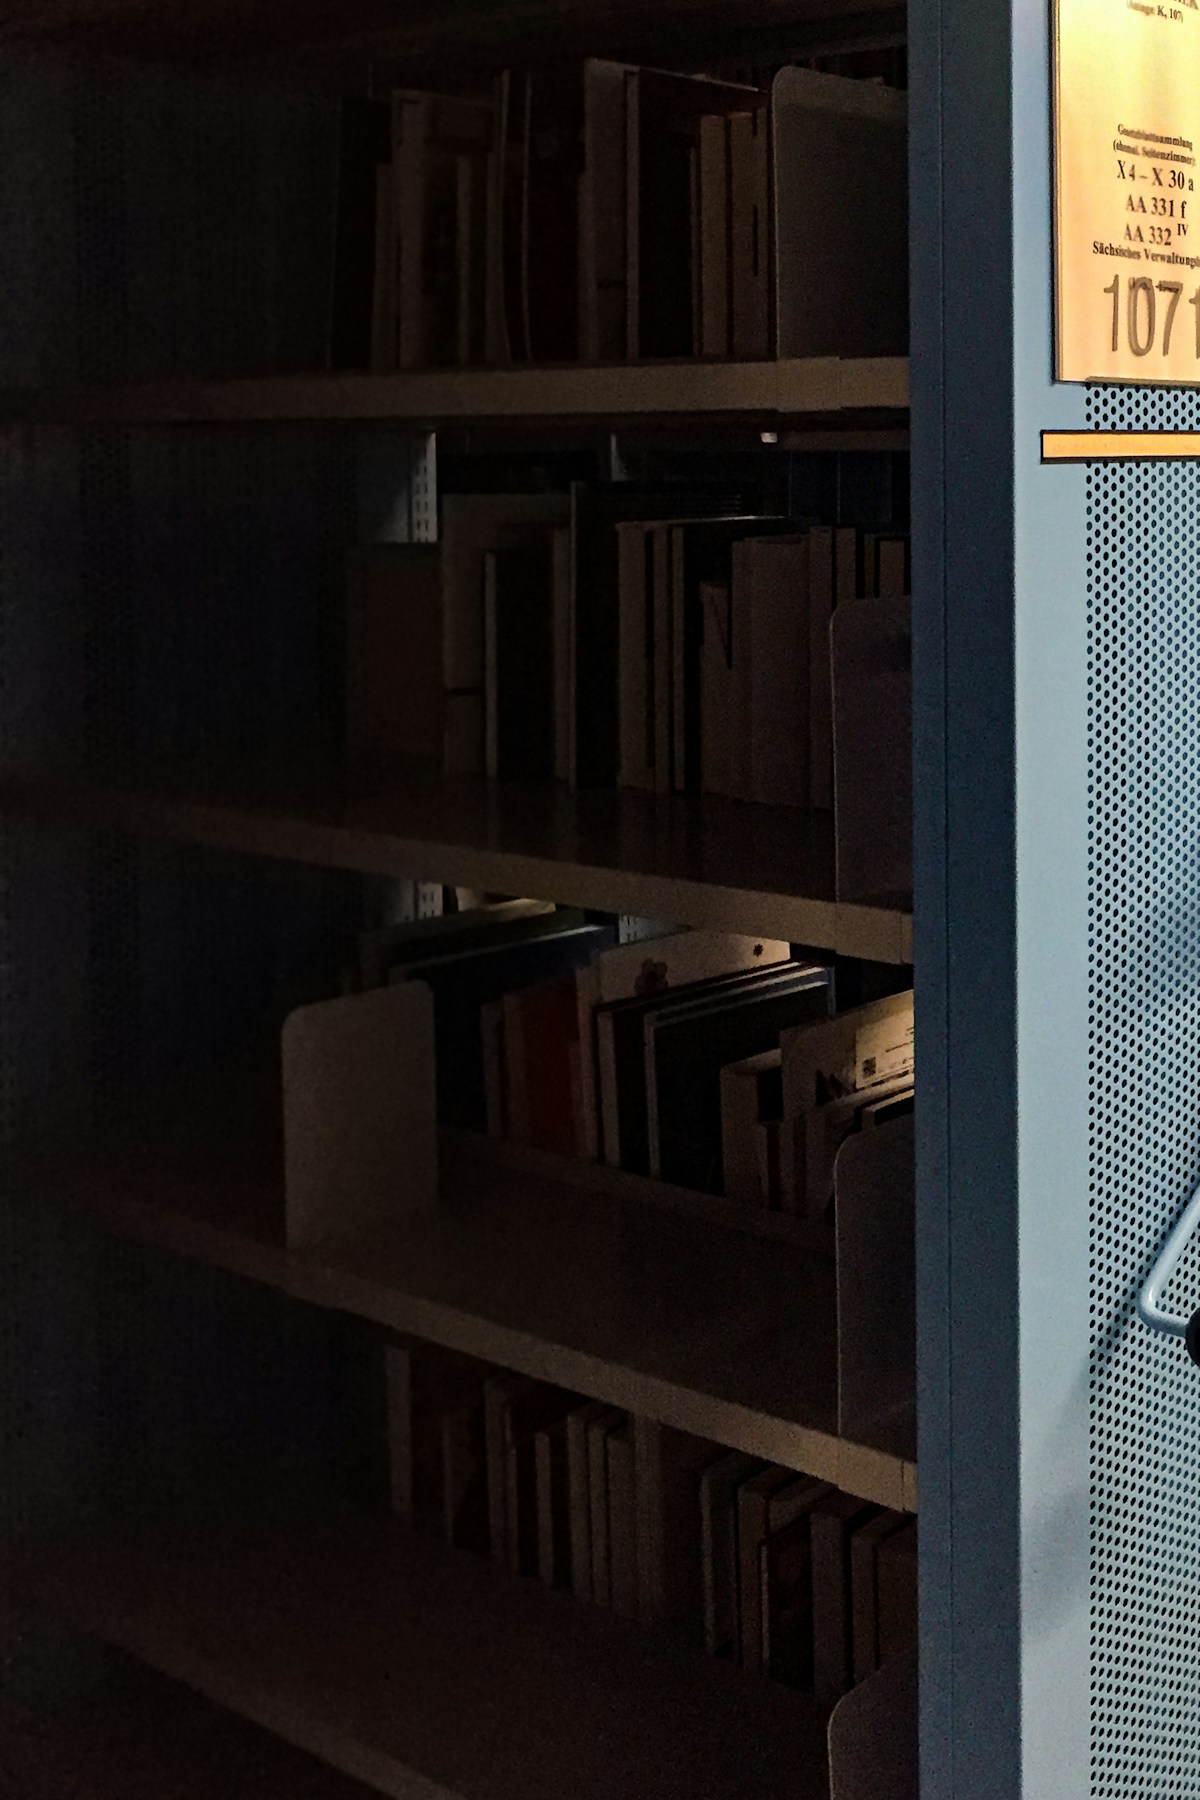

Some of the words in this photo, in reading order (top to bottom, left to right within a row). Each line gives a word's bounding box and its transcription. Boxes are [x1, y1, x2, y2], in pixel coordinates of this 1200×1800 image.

[1117, 159, 1126, 180] X
[1128, 164, 1136, 182] 4
[1151, 166, 1164, 187] X
[1168, 169, 1185, 190] 30
[1188, 177, 1194, 192] a
[1125, 194, 1147, 214] AA
[1151, 196, 1175, 218] 331
[1180, 200, 1188, 219] f
[1124, 223, 1145, 243] AA
[1148, 225, 1172, 246] 332
[1177, 223, 1189, 237] IV
